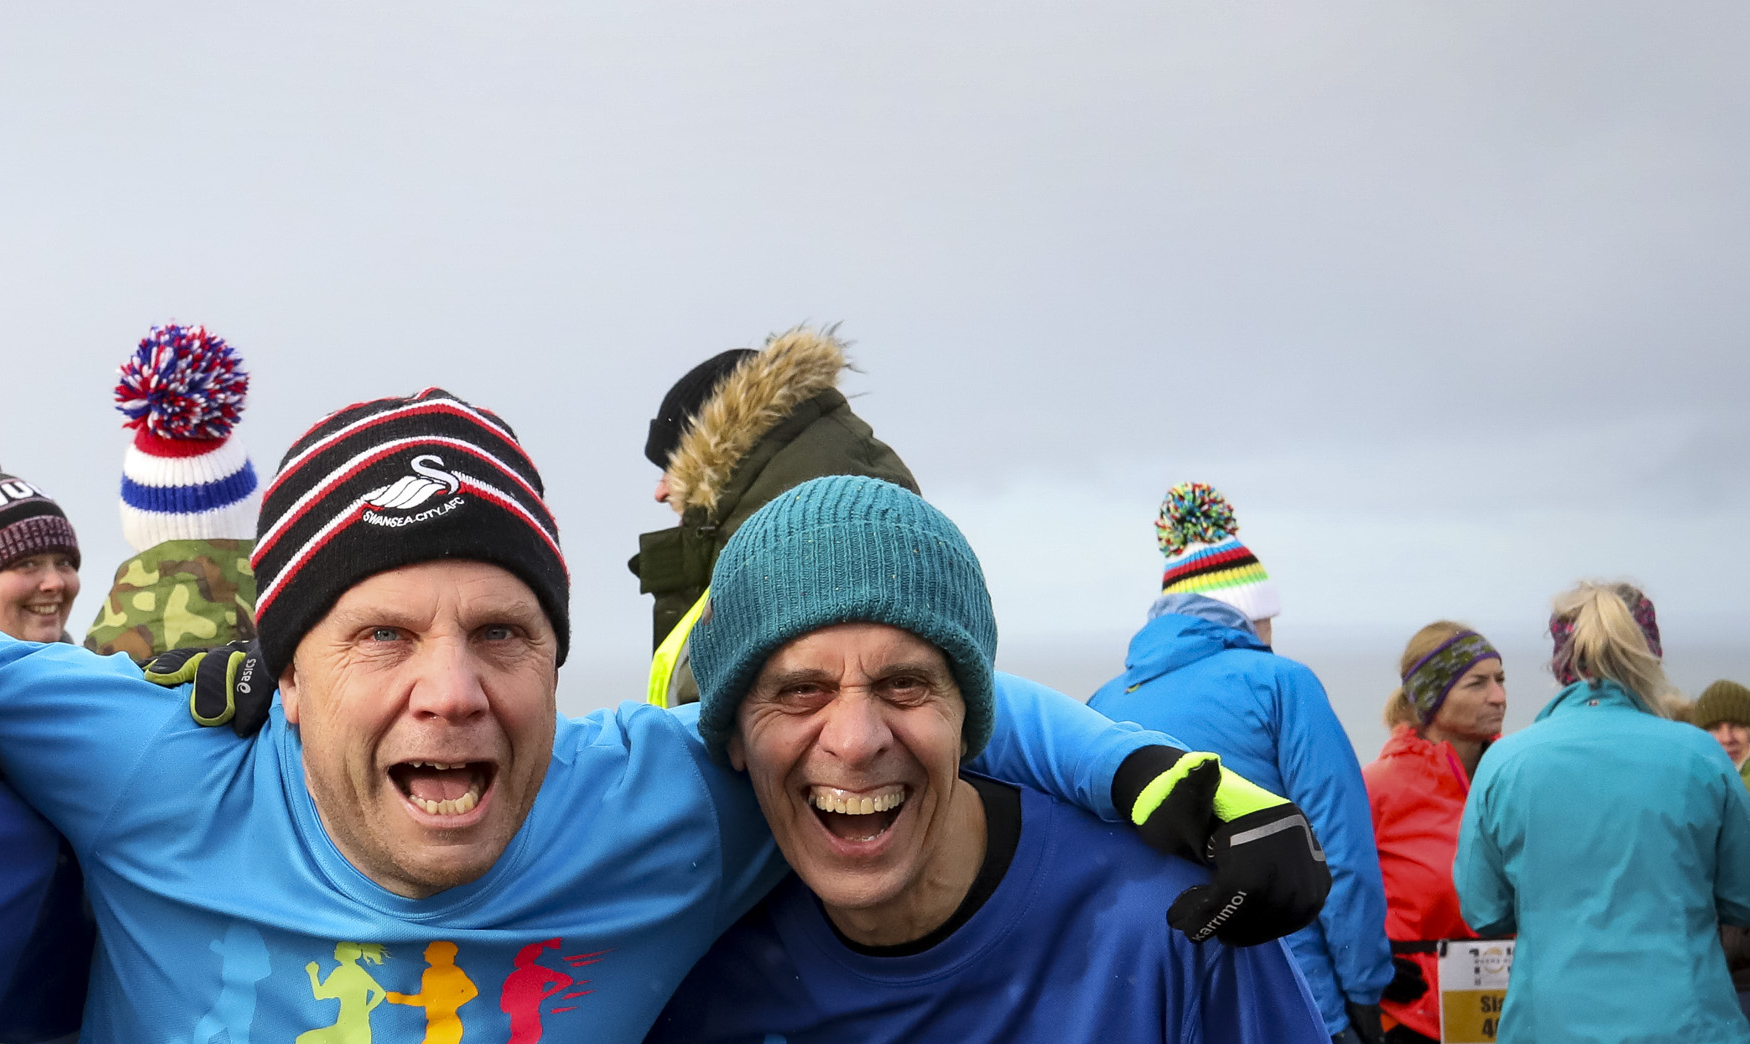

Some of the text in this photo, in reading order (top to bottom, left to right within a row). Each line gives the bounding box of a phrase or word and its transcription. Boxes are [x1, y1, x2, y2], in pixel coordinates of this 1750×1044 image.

[363, 497, 465, 527] SWANSEA CITY AFC
[240, 658, 257, 682] asics
